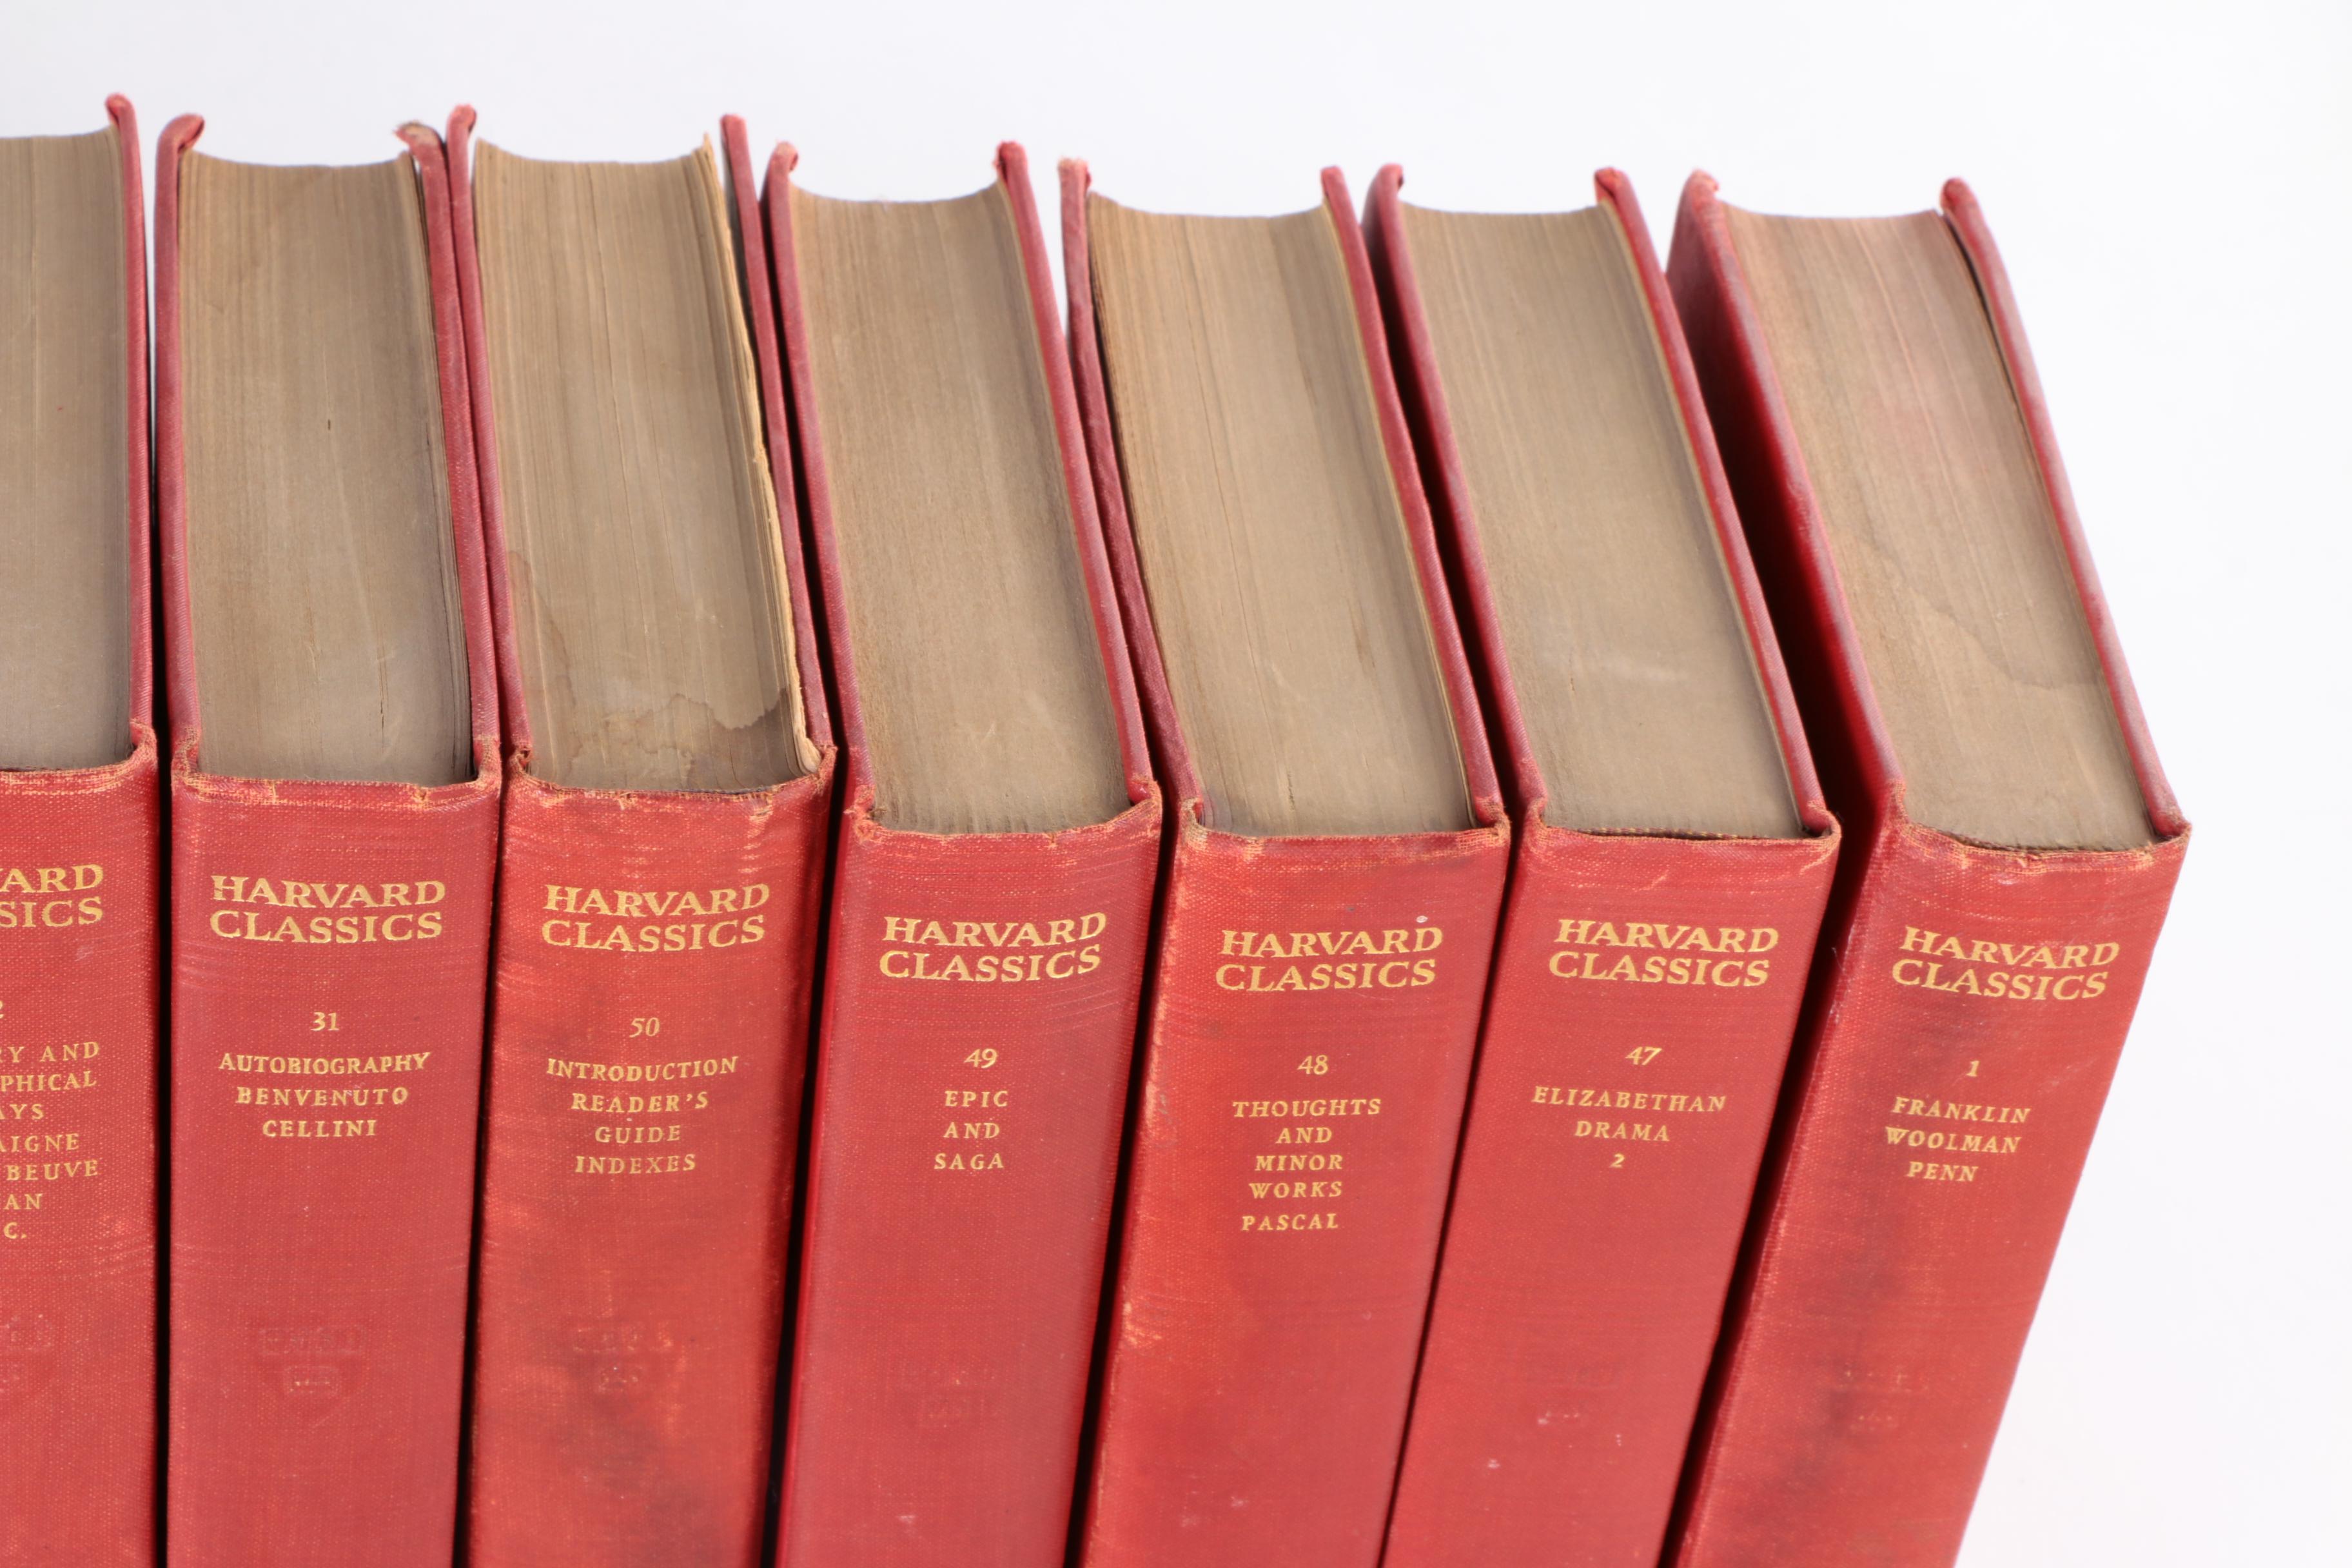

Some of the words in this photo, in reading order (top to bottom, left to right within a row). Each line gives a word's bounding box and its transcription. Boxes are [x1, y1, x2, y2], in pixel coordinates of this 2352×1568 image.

[0, 863, 104, 894] ARD
[211, 875, 446, 908] HARVARD
[544, 883, 770, 918] HARVARD
[210, 909, 443, 944] CLASSICS
[542, 914, 765, 952] CLASSICS
[883, 912, 1107, 948] HARVARD
[1554, 918, 1780, 954] HARVARD
[1220, 926, 1444, 958] HARVARD
[1899, 926, 2121, 970] HARVARD
[879, 943, 1101, 982] CLASSICS
[1549, 950, 1770, 987] CLASSICS
[1216, 959, 1436, 992] CLASSICS
[1892, 958, 2109, 1001] CLASSICS
[311, 1011, 338, 1031] 31
[631, 1017, 661, 1038] 50
[41, 1041, 100, 1063] AND
[965, 1048, 999, 1068] 49
[1627, 1046, 1662, 1066] 47
[220, 1052, 431, 1074] AUTOBIOGRAPHY
[547, 1055, 738, 1082] INTRODUCTION
[1298, 1054, 1329, 1075] 48
[1967, 1060, 1980, 1077] 1
[237, 1086, 409, 1106] BENVENUTO
[571, 1091, 709, 1113] READER'S
[945, 1090, 1008, 1108] EPIC
[1533, 1086, 1727, 1112] ELIZABETHAN
[1233, 1098, 1382, 1118] THOUGHTS
[1893, 1096, 2032, 1124] FRANKLIN
[263, 1119, 376, 1138] CELLINI
[595, 1124, 681, 1144] GUIDE
[945, 1121, 1001, 1139] AND
[1277, 1126, 1333, 1144] AND
[1575, 1120, 1670, 1142] DRAMA
[1886, 1126, 2022, 1154] WOOLMAN
[7, 1159, 98, 1181] BEUVE
[576, 1153, 696, 1174] INDEXES
[934, 1152, 1004, 1170] SAGA
[1255, 1154, 1343, 1171] MINOR
[1611, 1153, 1625, 1168] 2
[1908, 1161, 1979, 1182] PENN
[1250, 1181, 1342, 1199] WORKS
[4, 1193, 42, 1210] AN
[4, 1222, 27, 1239] C.
[1242, 1213, 1338, 1231] PASCAL
